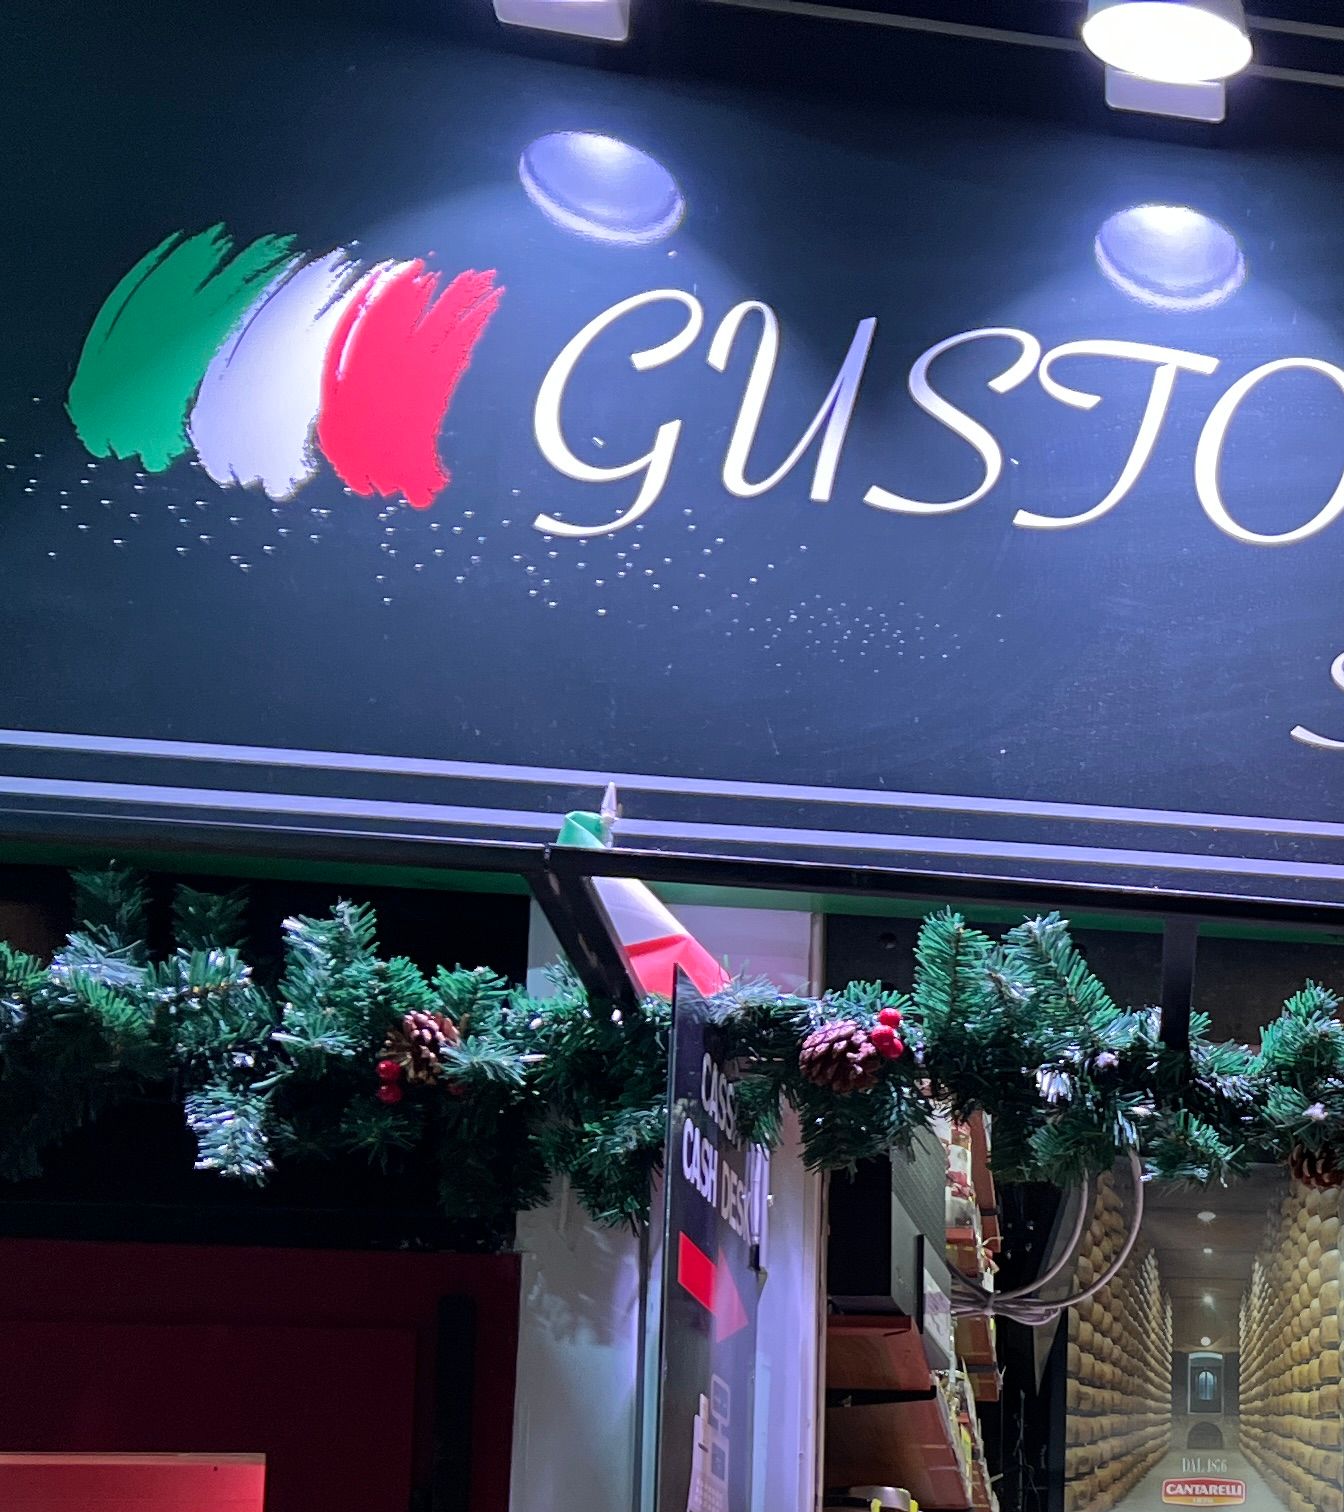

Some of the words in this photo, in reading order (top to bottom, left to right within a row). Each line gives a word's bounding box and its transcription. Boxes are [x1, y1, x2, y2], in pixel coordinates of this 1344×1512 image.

[701, 1052, 740, 1148] CASS
[681, 1118, 719, 1210] CASH
[1166, 1483, 1242, 1498] CANTARELLI
